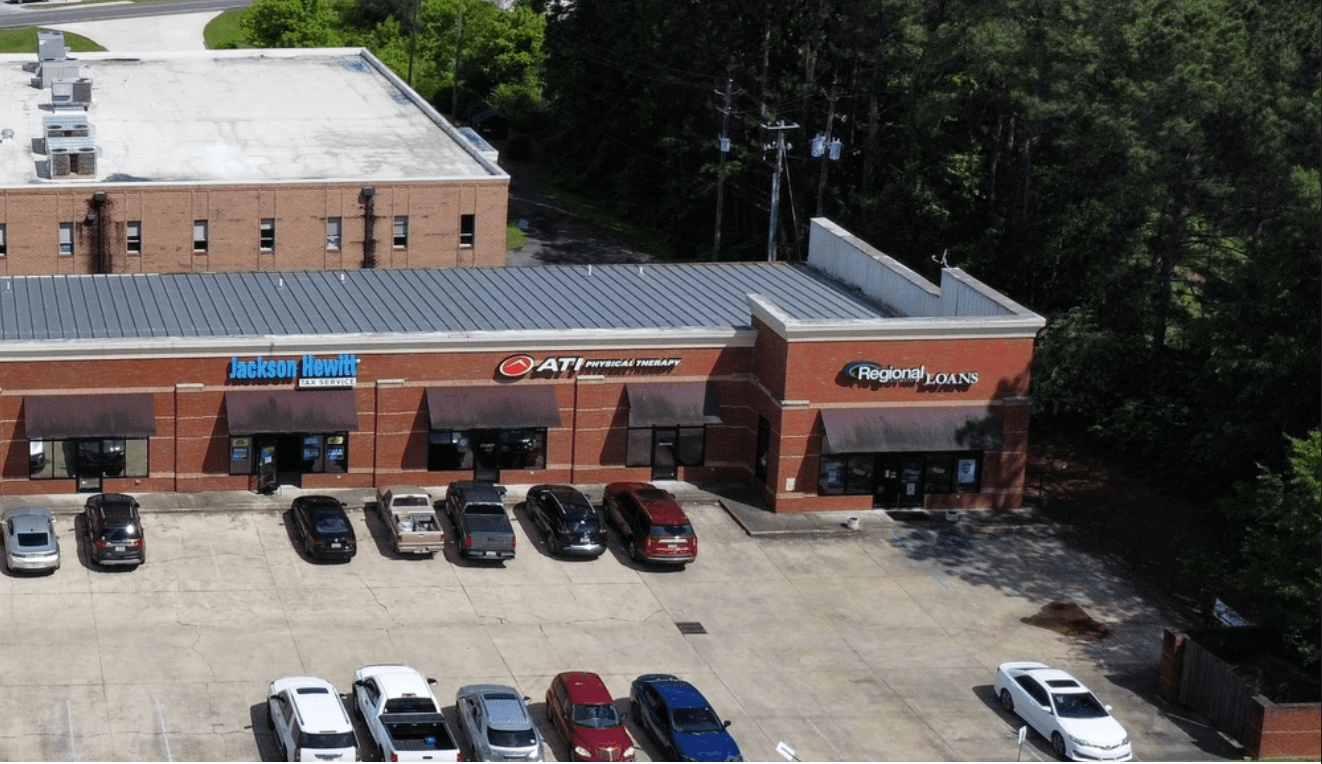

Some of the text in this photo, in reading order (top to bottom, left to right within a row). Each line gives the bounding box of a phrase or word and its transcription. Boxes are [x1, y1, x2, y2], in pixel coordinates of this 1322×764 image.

[229, 354, 357, 378] Jackson Hewitt
[536, 357, 682, 372] ATI PHYSICAL THERAPY
[318, 378, 355, 386] SERVICE
[858, 366, 978, 386] Regional LOANS
